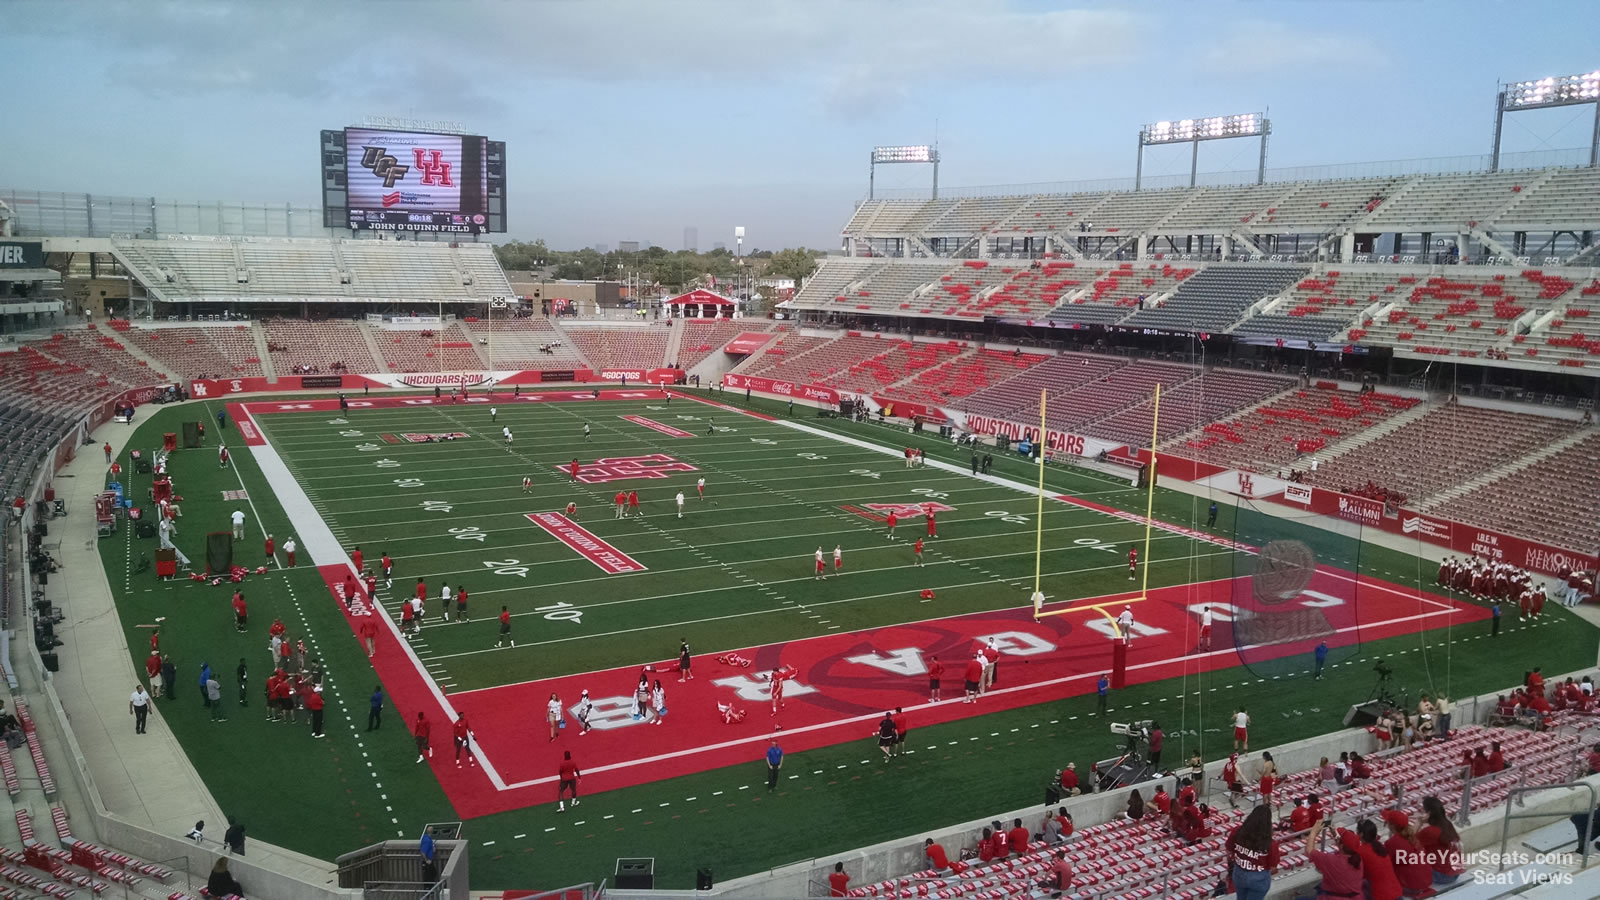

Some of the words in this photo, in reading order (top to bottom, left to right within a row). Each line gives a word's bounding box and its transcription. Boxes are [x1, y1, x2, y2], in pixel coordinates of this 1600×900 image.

[361, 146, 410, 188] UCF
[412, 148, 453, 187] UH
[398, 223, 439, 231] O'QUINN
[193, 383, 208, 396] UH
[967, 414, 1019, 441] HOUSTON
[1238, 473, 1253, 495] UH
[1286, 485, 1310, 499] ESPN
[984, 510, 1031, 525] 20
[1348, 505, 1380, 521] ALUMNI
[1420, 519, 1449, 530] Maintenance
[1420, 524, 1435, 532] Supply
[448, 526, 487, 542] 30
[1420, 528, 1450, 540] Headquarters
[1073, 538, 1120, 554] 10
[1471, 542, 1491, 555] LOCAL
[594, 551, 635, 572] FIELD
[1526, 547, 1590, 570] MEMORIAL
[483, 559, 530, 578] 20
[535, 602, 584, 624] 10
[999, 832, 1007, 845] 7
